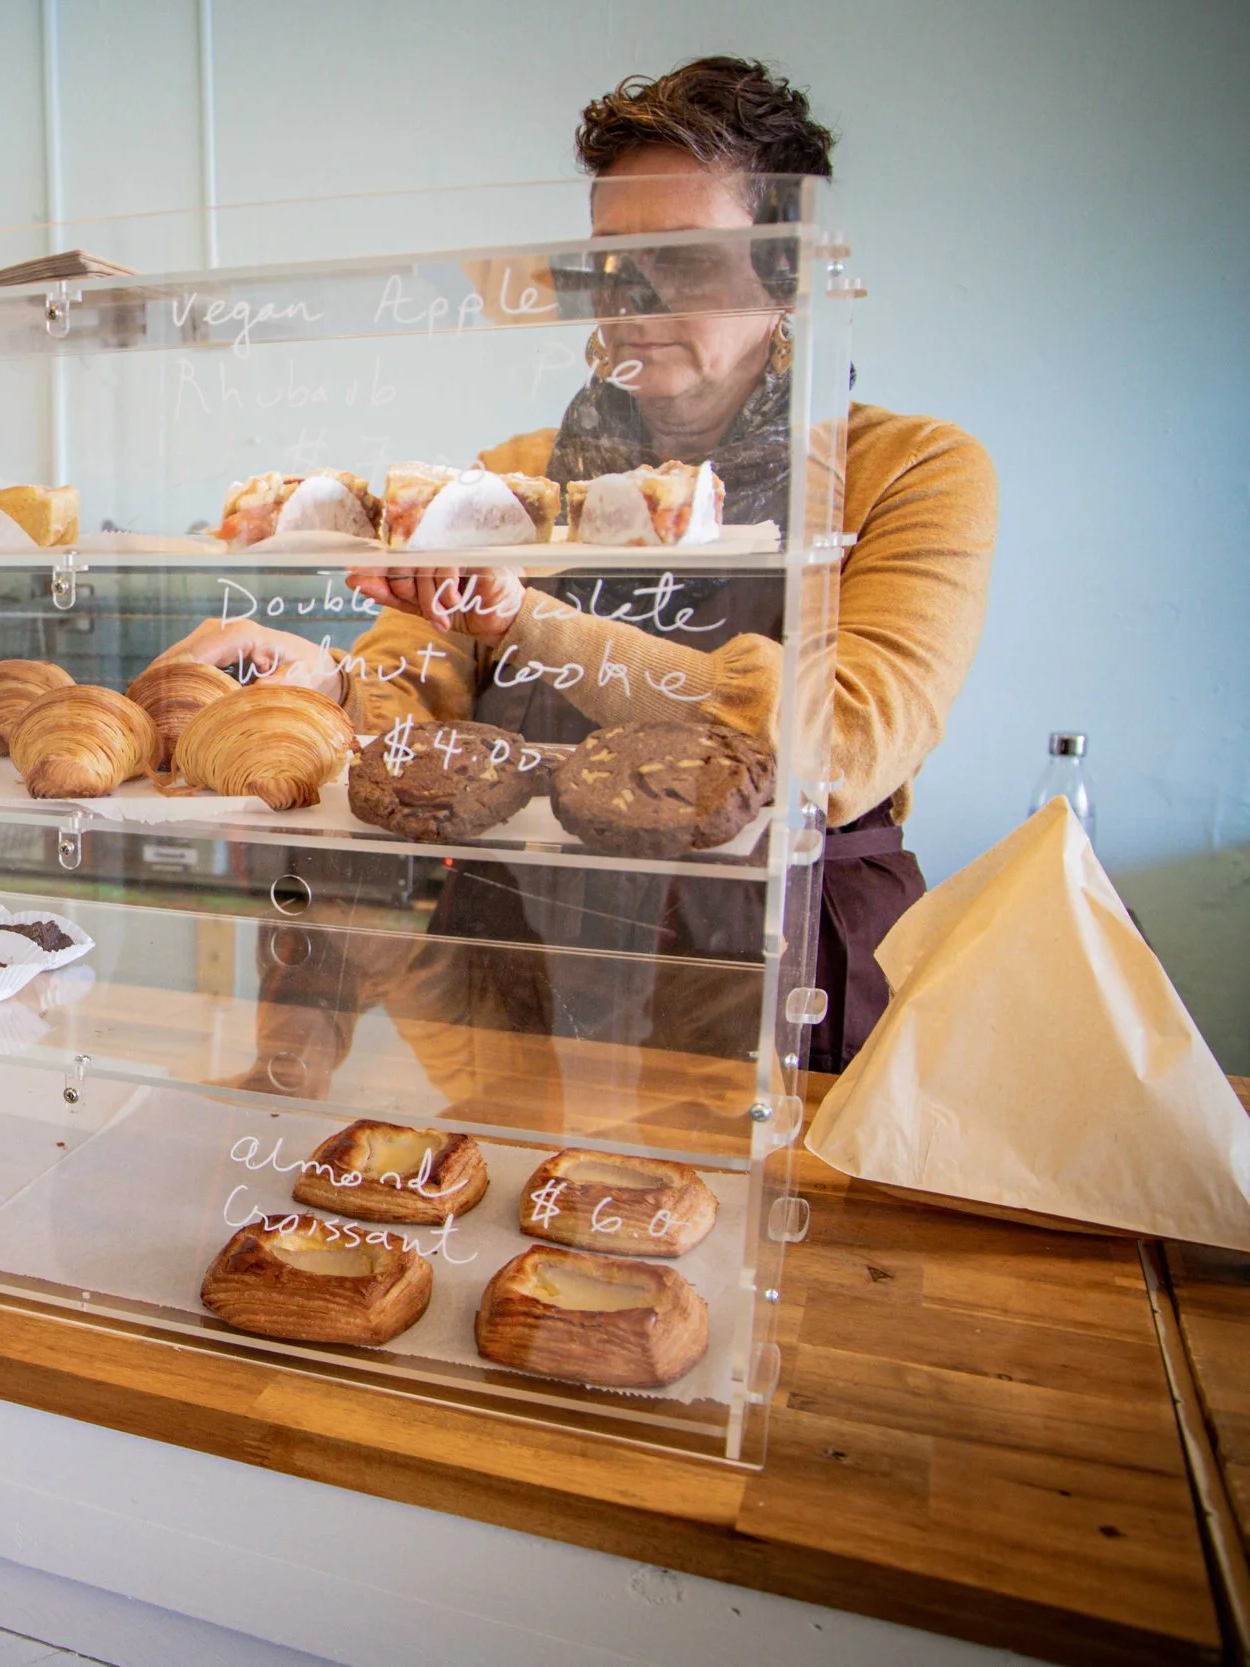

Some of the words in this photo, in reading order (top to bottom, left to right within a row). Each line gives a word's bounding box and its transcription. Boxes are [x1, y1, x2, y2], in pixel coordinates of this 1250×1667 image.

[374, 267, 560, 338] Apple
[175, 357, 398, 420] Rhubarb
[531, 342, 643, 404] Pie
[217, 578, 381, 630] Double
[431, 571, 726, 632] Chocolate
[238, 635, 447, 684] Walnut
[223, 1186, 479, 1265] Croissant
